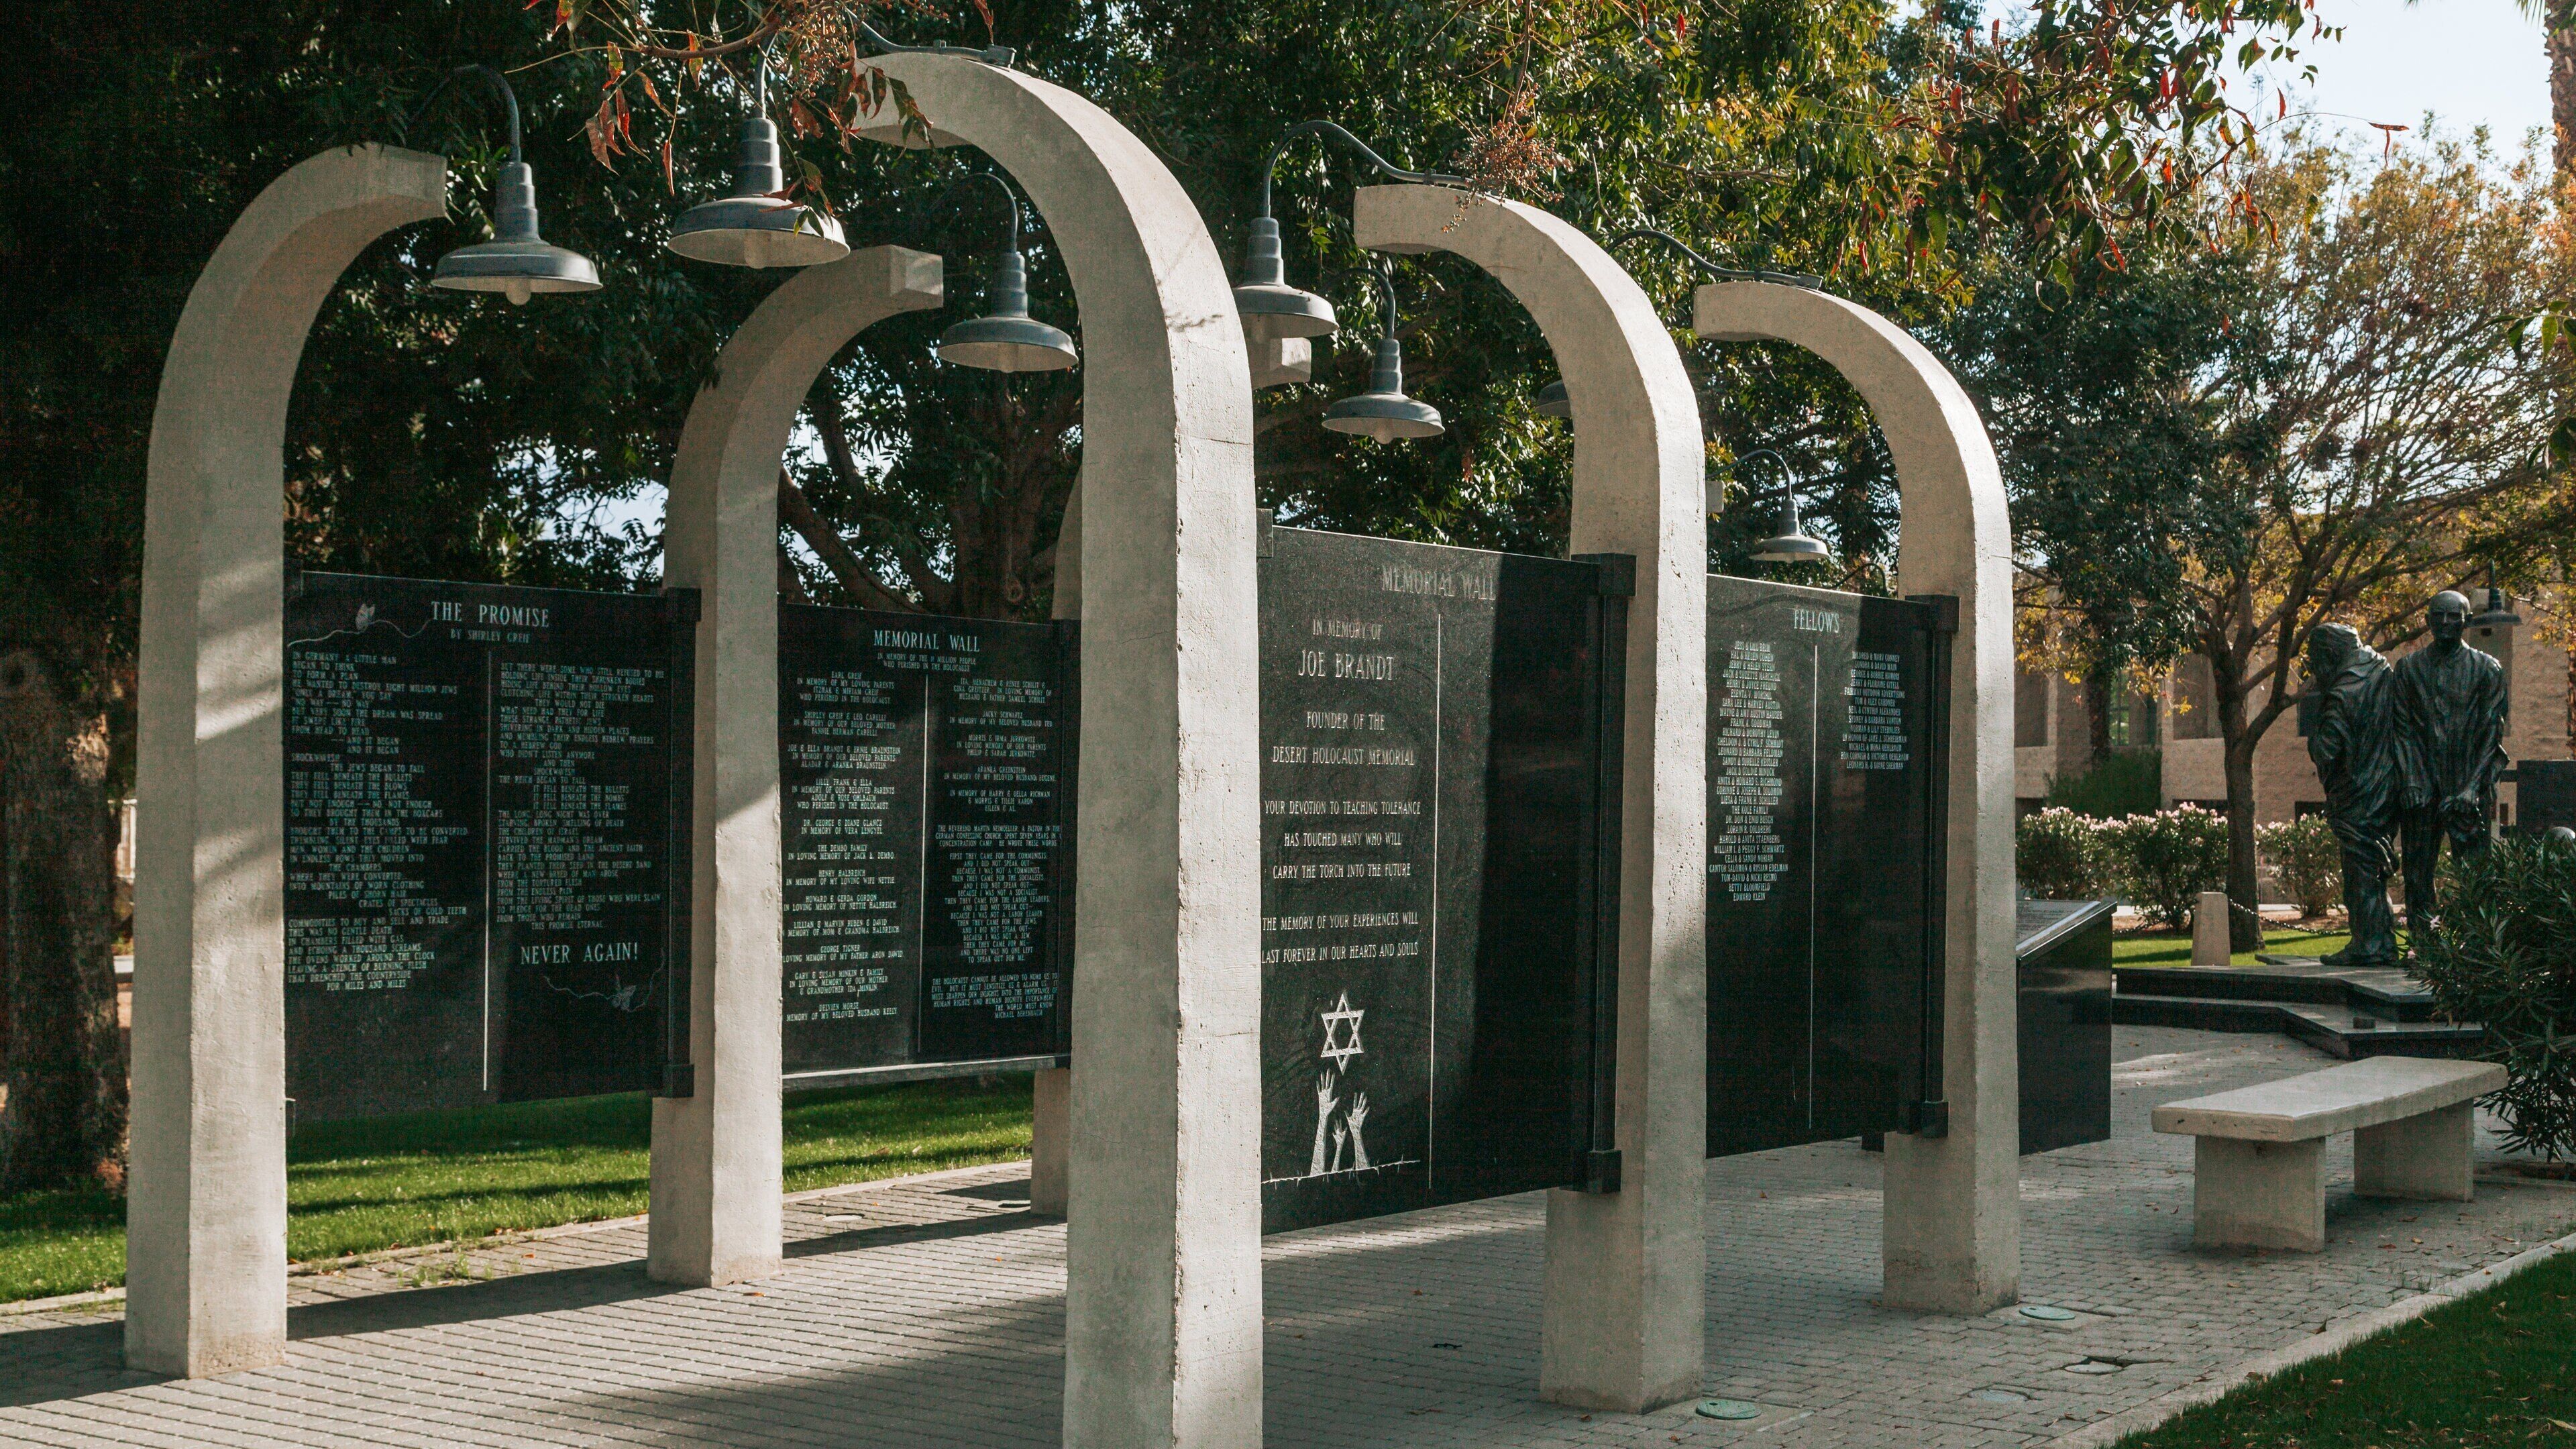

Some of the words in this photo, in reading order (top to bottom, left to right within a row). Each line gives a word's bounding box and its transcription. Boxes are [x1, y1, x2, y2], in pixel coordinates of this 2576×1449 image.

[1382, 565, 1455, 596] MEMORIAL
[1462, 574, 1496, 600] WALL
[431, 601, 462, 622] THE
[479, 604, 549, 627] PROMISE
[1794, 608, 1840, 633] FELLOWS
[450, 629, 462, 639] BY
[468, 630, 501, 641] SHIRLEY
[1313, 620, 1323, 636] IN
[1328, 621, 1366, 639] MEMORY
[1371, 623, 1382, 640] OF
[873, 630, 939, 649] MEMORIAL
[949, 635, 980, 652] WALL
[1298, 649, 1326, 678] JOE
[1335, 652, 1394, 681] BRANDT
[831, 671, 845, 679] EARL
[535, 699, 550, 707] THEY
[555, 700, 576, 708] WOULD
[580, 700, 591, 708] NOT
[1307, 711, 1348, 729] FOUNDER
[1352, 712, 1364, 730] OF
[1368, 713, 1385, 731] THE
[1273, 746, 1308, 763] DESERT
[1311, 747, 1364, 764] HOLOCAUST
[1368, 749, 1414, 765] MEMORIAL
[1265, 800, 1285, 814] YOUR
[1289, 801, 1326, 814] DEVOTION
[1330, 801, 1340, 814] TO
[1342, 801, 1378, 814] TEACHING
[1381, 801, 1421, 815] TOLERANCE
[1731, 806, 1740, 814] THE
[1753, 806, 1768, 814] FAMILY
[1284, 833, 1299, 847] HAS
[1303, 833, 1337, 847] TOUCHED
[1340, 833, 1361, 847] MANY
[1365, 833, 1382, 846] WHO
[1385, 833, 1401, 846] WILL
[1273, 865, 1298, 879] CARRY
[1302, 865, 1316, 878] THE
[1320, 865, 1344, 878] TORCH
[1347, 864, 1364, 877] INTO
[1367, 864, 1381, 877] THE
[1385, 863, 1411, 877] FUTURE
[1709, 864, 1727, 873] CANTOR
[1729, 883, 1742, 892] BETTY
[358, 899, 384, 908] CRATES
[388, 899, 396, 907] OF
[806, 895, 827, 903] HOWARD
[1733, 893, 1751, 901] EDWARD
[1752, 892, 1766, 900] KLEIN
[426, 907, 443, 915] GOLD
[447, 906, 466, 915] TEETH
[1262, 917, 1277, 931] THE
[1281, 916, 1313, 930] MEMORY
[1317, 915, 1326, 928] OF
[1330, 914, 1350, 928] YOUR
[1353, 912, 1399, 927] EXPERIENCES
[1402, 912, 1418, 925] WILL
[288, 955, 303, 964] THE
[306, 955, 329, 964] OVENS
[334, 954, 362, 963] WORKED
[366, 953, 394, 962] AROUND
[398, 953, 410, 961] THE
[414, 952, 435, 961] CLOCK
[521, 945, 571, 965] NEVER
[584, 942, 638, 962] AGAIN!
[1261, 949, 1279, 964] LAST
[1283, 947, 1316, 963] FOREVER
[1319, 947, 1328, 961] IN
[1332, 946, 1346, 960] OUR
[1350, 944, 1377, 959] HEARTS
[1379, 943, 1395, 957] AND
[1397, 942, 1418, 957] SOULS
[818, 971, 835, 979] SUSAN
[867, 968, 883, 976] FAMILY
[327, 982, 340, 991] FOR
[345, 981, 364, 990] MILES
[368, 981, 383, 989] AND
[387, 980, 406, 988] MILES
